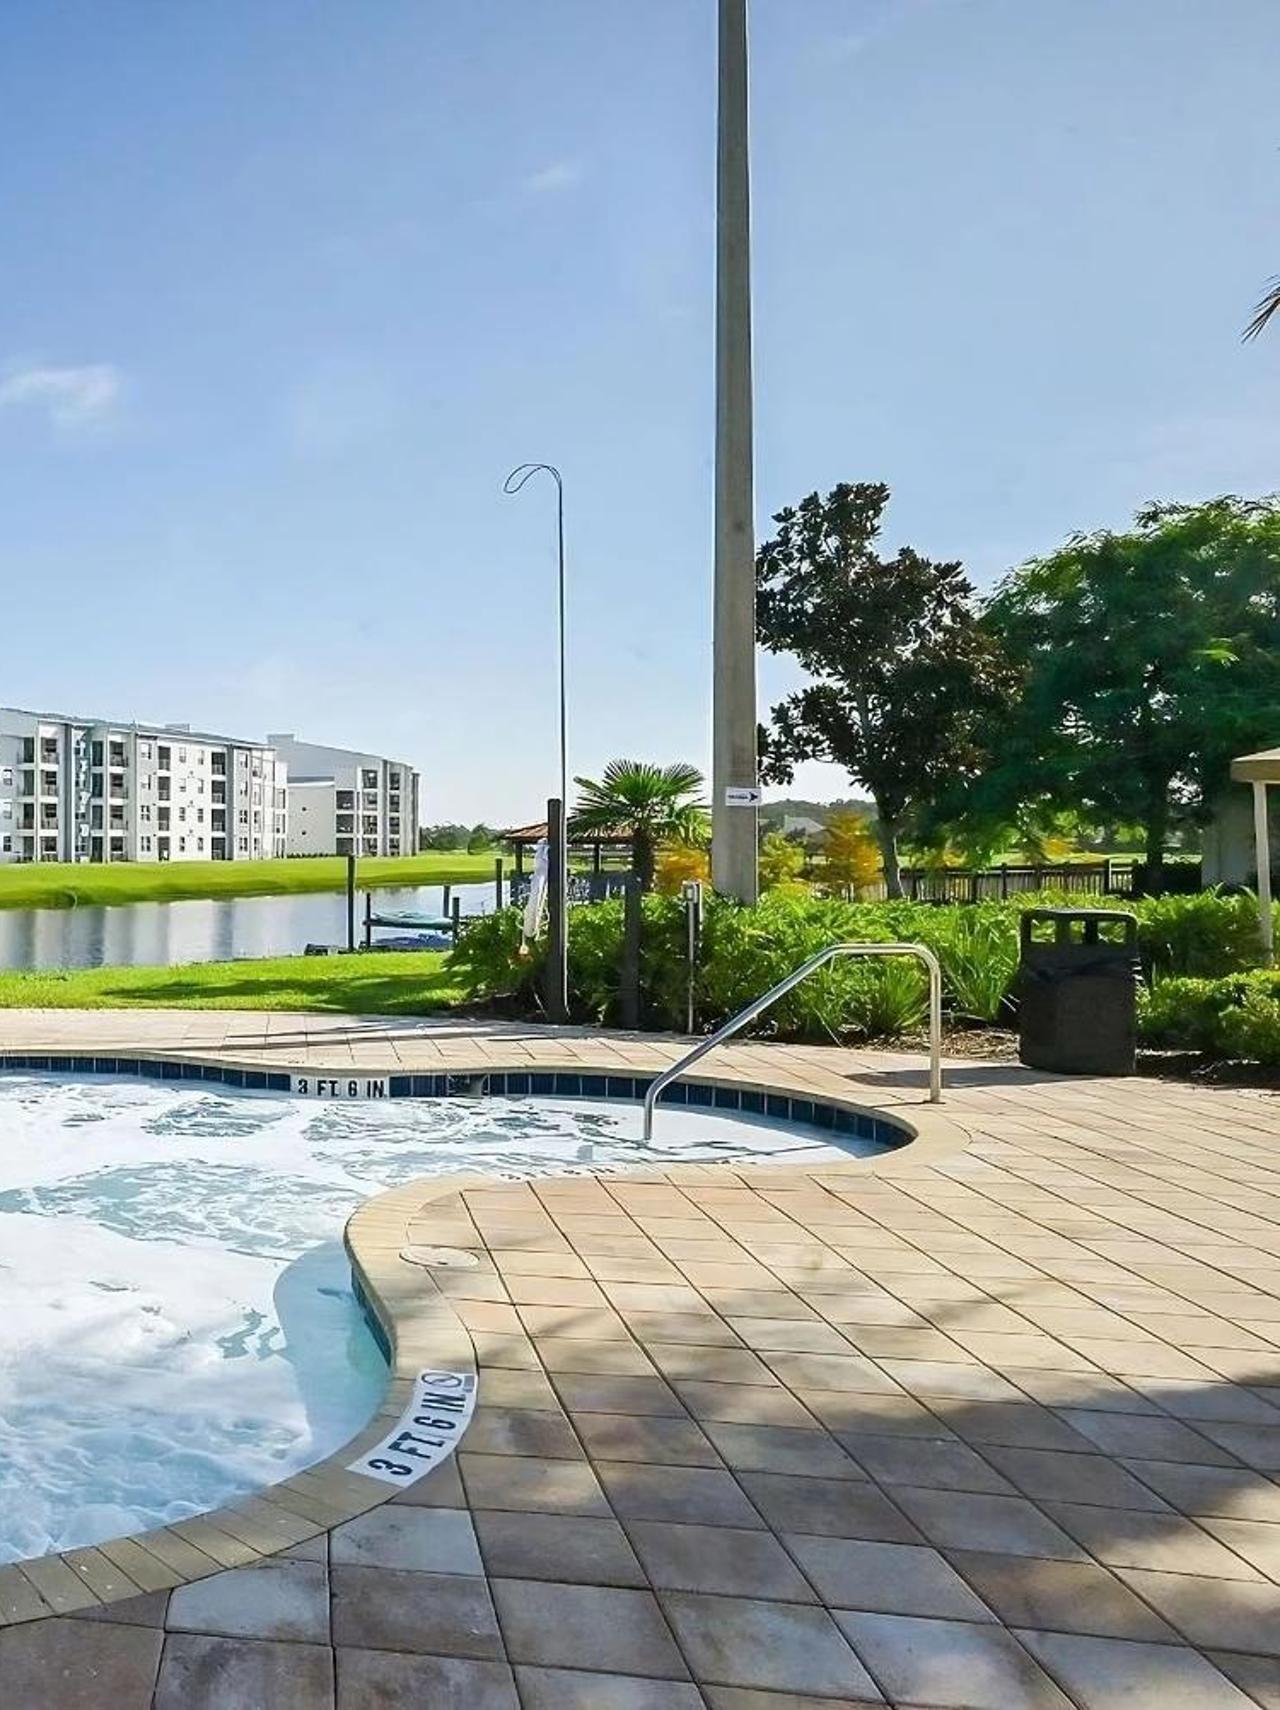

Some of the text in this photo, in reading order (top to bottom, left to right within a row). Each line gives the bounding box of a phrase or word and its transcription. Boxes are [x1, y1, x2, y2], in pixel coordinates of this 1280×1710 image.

[298, 1078, 308, 1095] 3
[347, 1080, 358, 1097] 6
[367, 1458, 413, 1476] 3
[413, 1415, 457, 1430] 6
